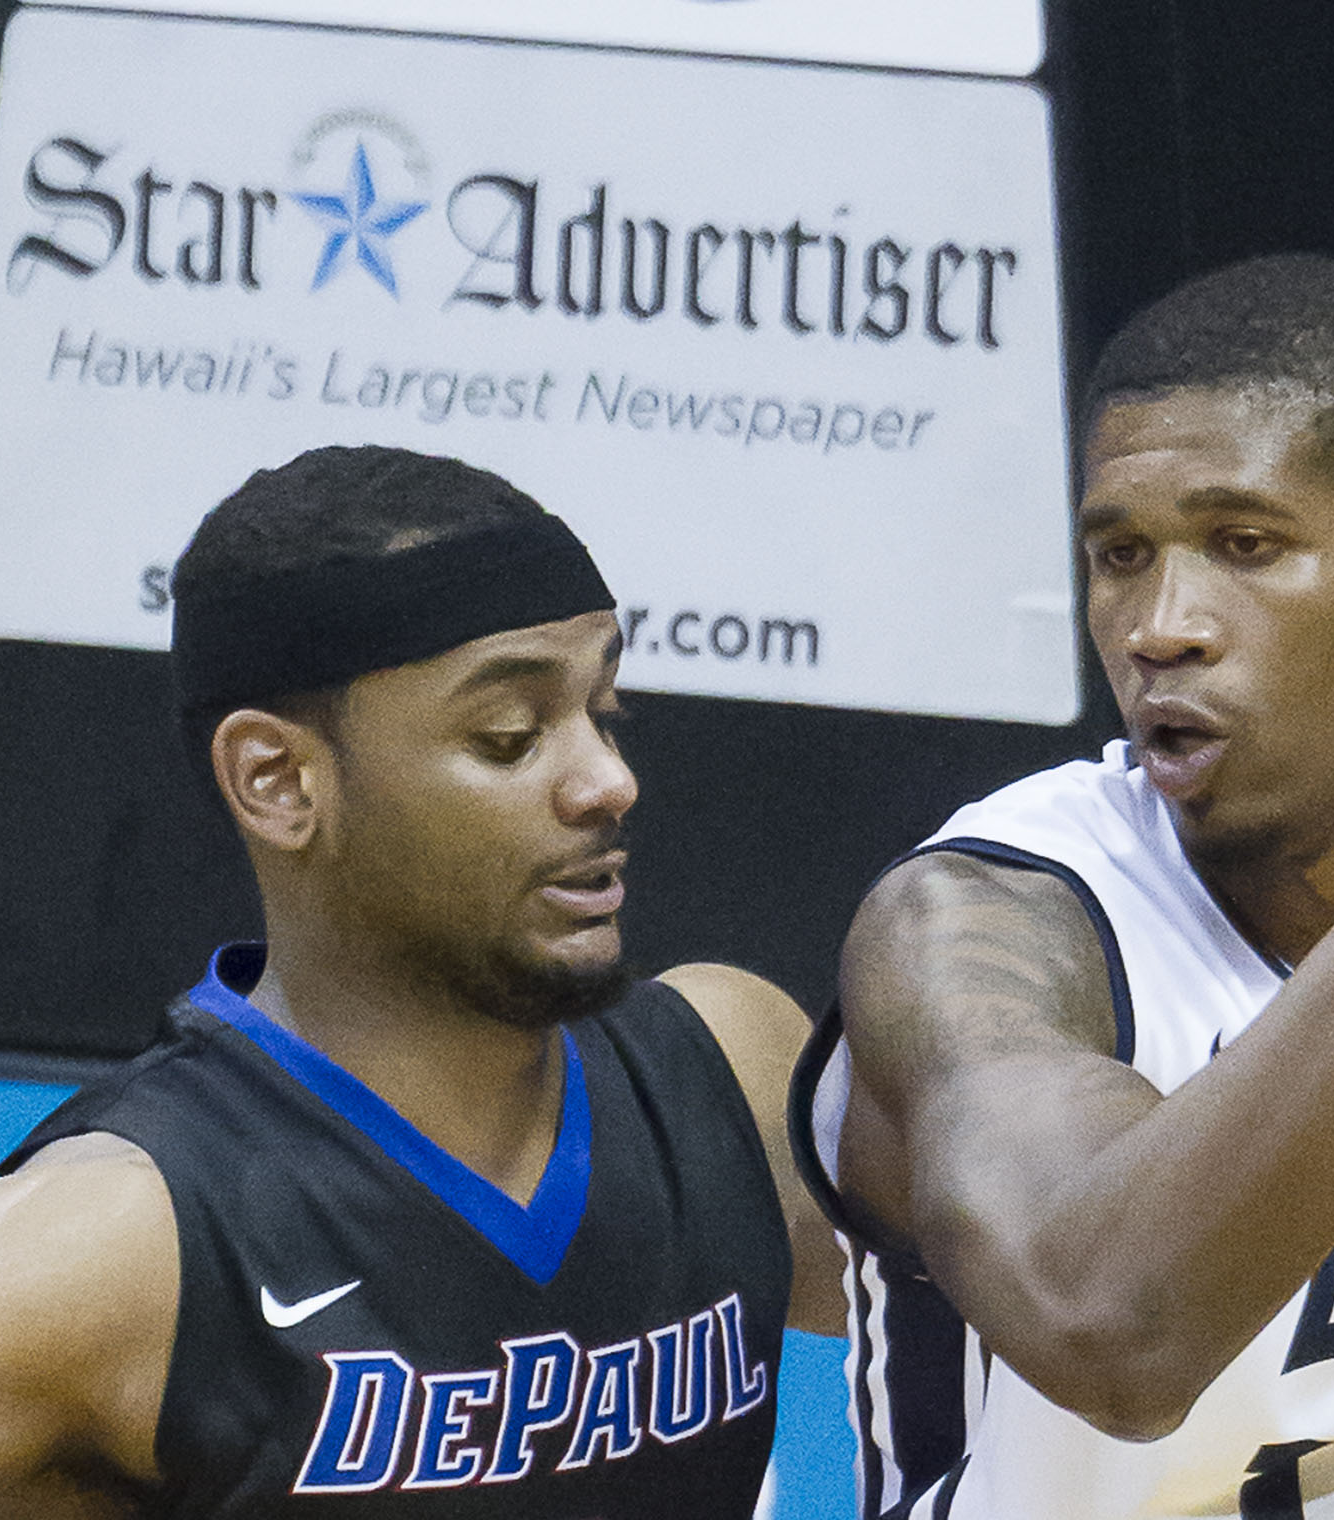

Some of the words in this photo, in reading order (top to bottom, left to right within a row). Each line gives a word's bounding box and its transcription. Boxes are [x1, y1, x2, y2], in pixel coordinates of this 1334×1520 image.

[5, 134, 279, 295] Star
[445, 168, 1019, 350] Advertiser
[48, 329, 297, 401] Hawaii's
[319, 349, 556, 424] Largest
[575, 371, 937, 453] Newspaper
